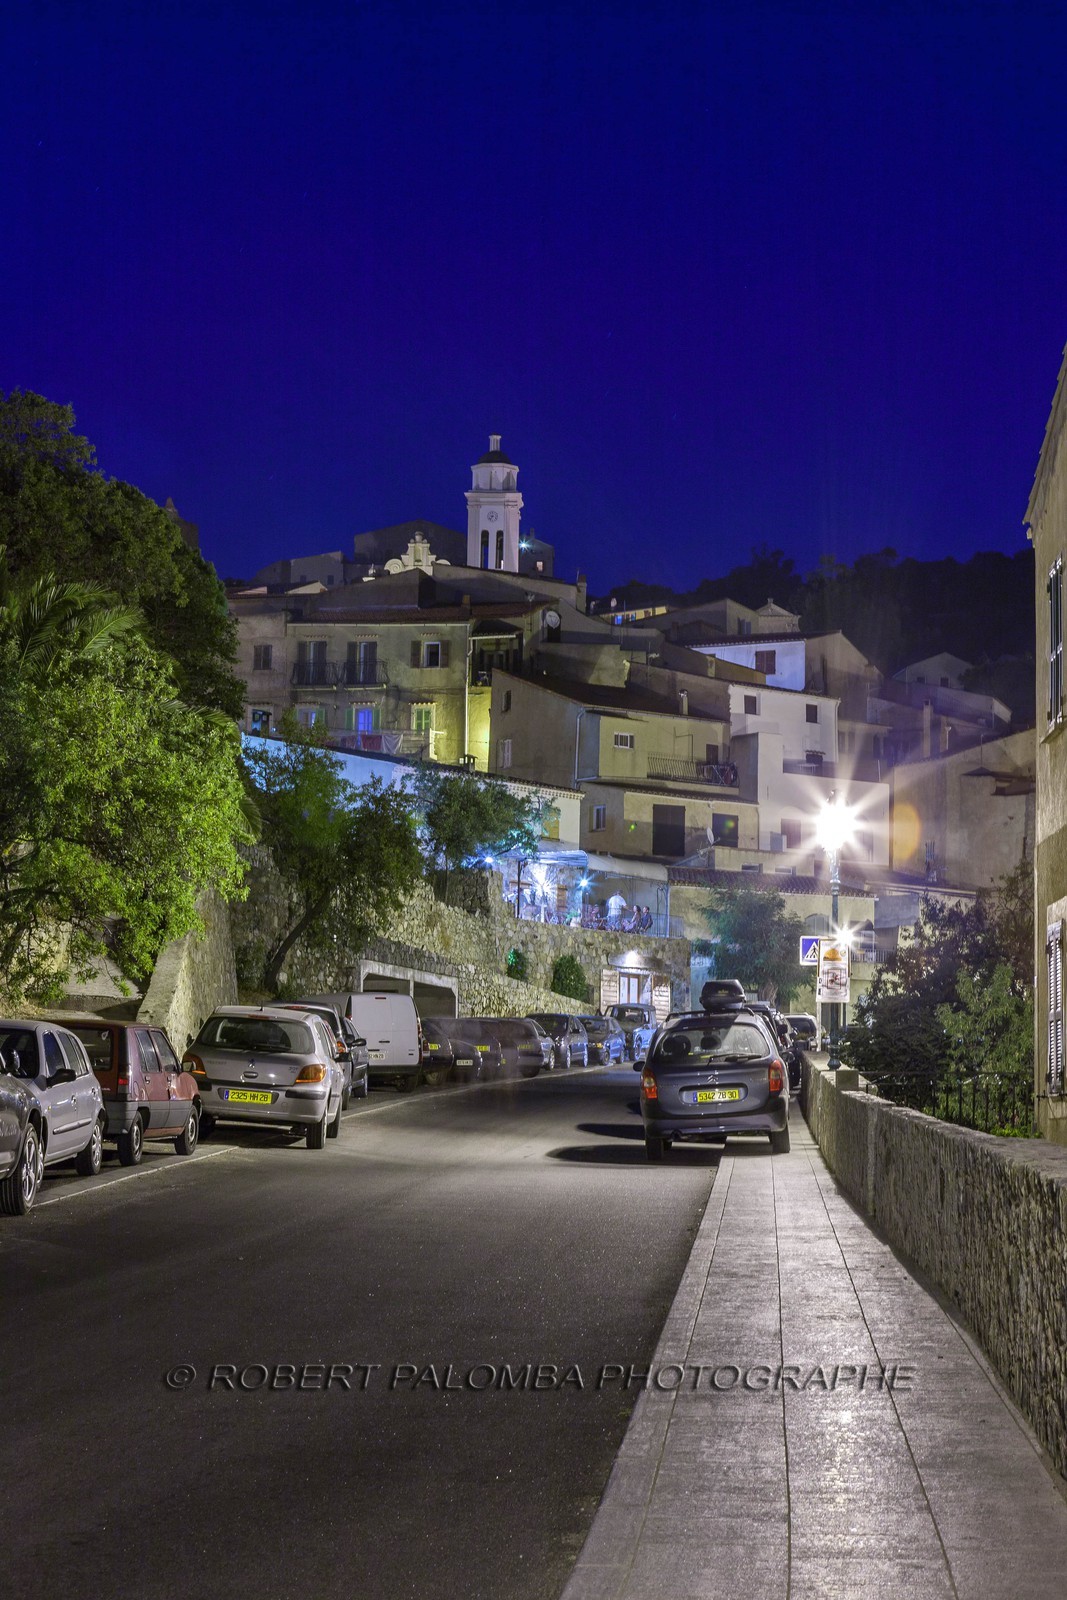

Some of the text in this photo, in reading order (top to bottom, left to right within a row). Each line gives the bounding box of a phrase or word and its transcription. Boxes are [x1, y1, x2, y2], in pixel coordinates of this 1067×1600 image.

[230, 1091, 248, 1100] 2325
[698, 1092, 716, 1101] 5342
[727, 1090, 737, 1099] 30
